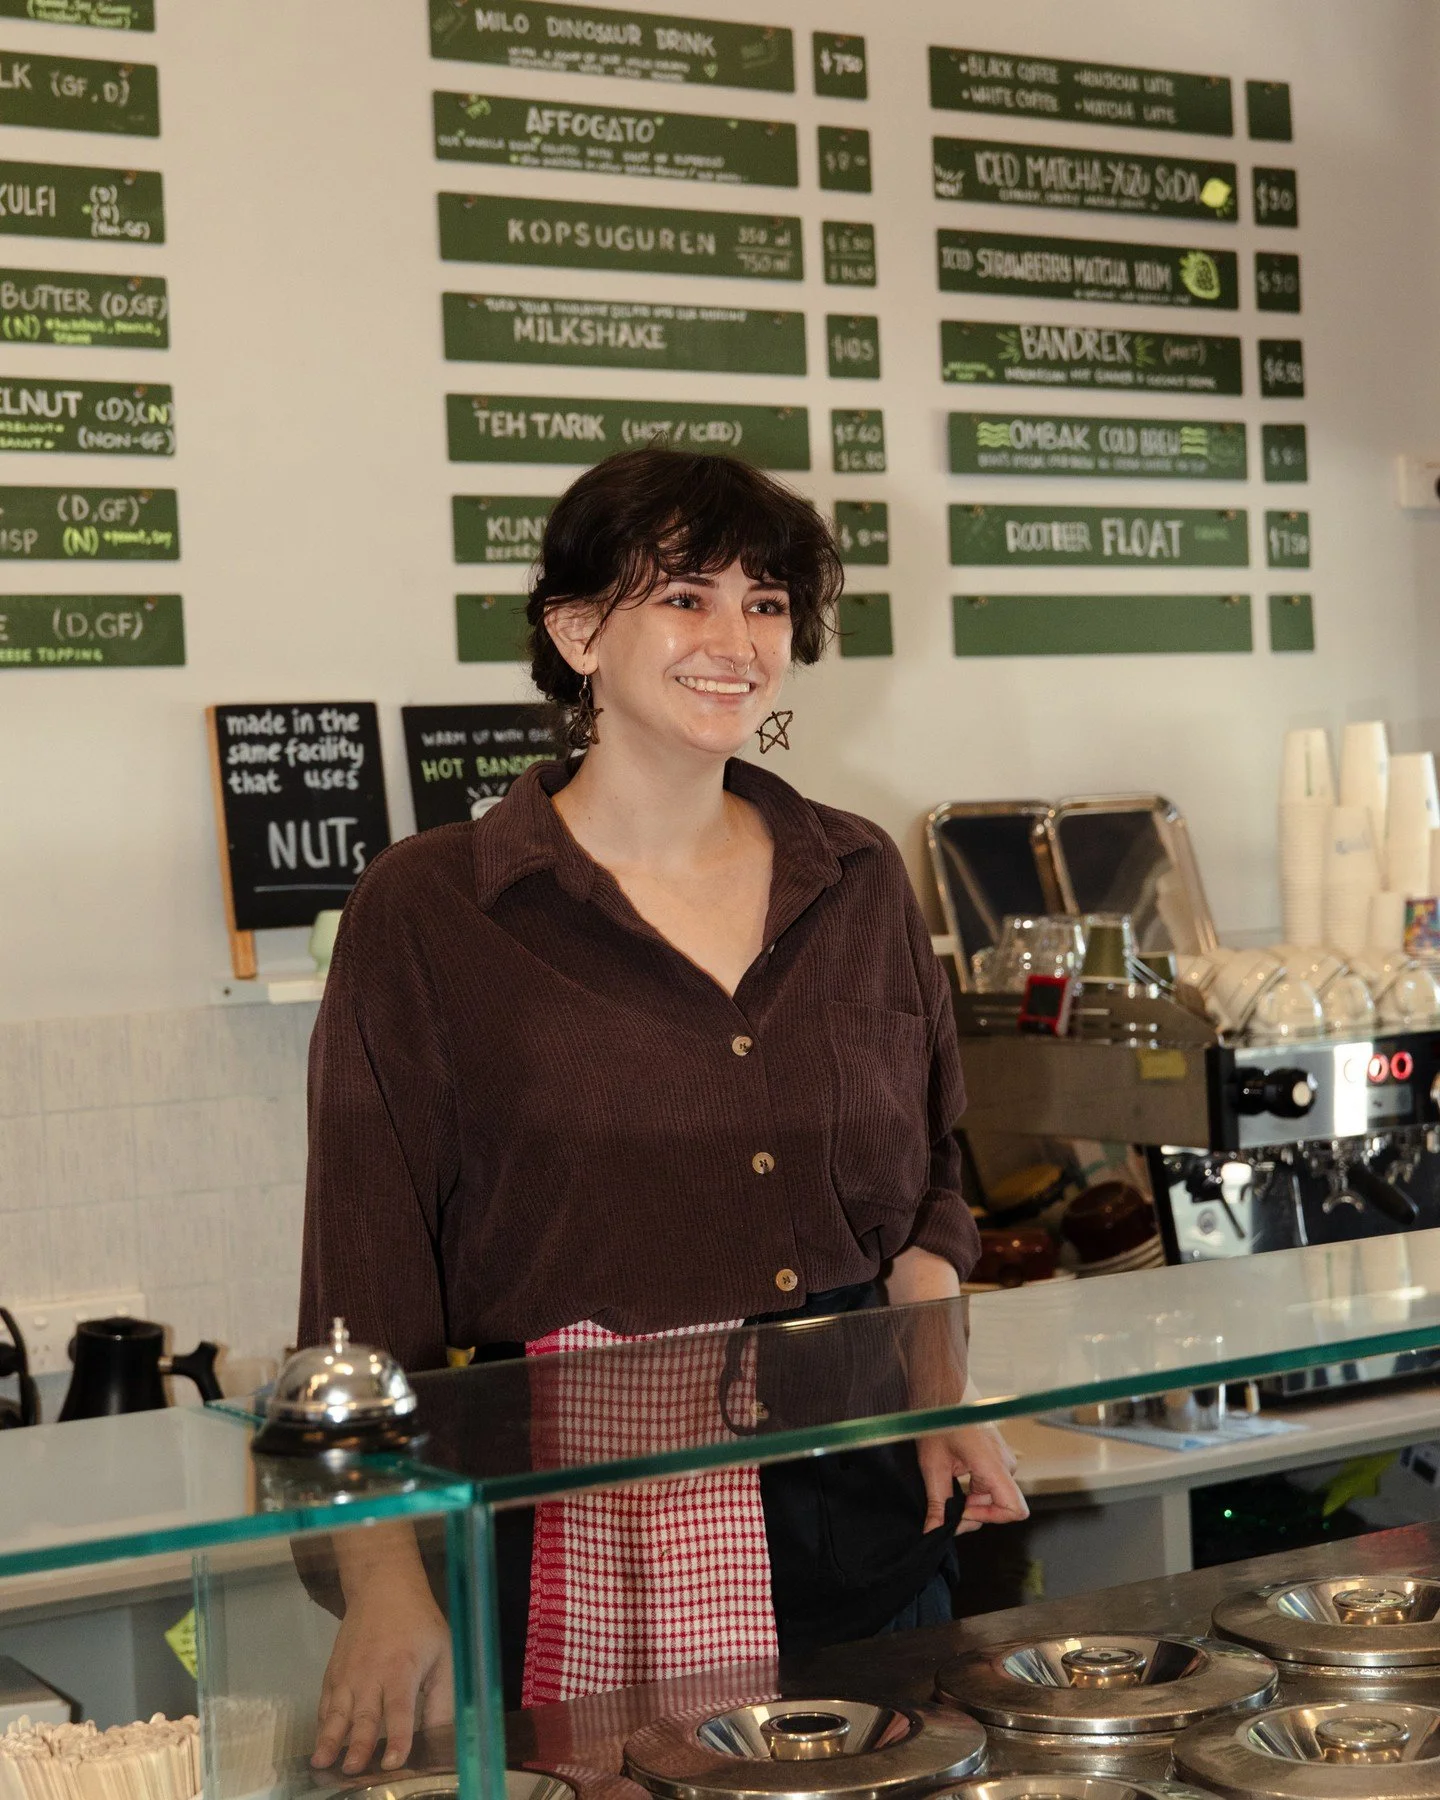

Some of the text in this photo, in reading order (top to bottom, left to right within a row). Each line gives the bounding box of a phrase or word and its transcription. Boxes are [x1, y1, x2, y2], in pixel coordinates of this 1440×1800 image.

[475, 8, 718, 58] MILO DINOSAUR DRINK
[525, 105, 656, 143] AFFOGATO
[0, 183, 56, 217] KULFI
[507, 218, 717, 256] KOPSUGUREN
[0, 280, 92, 313] BUTTER
[513, 315, 668, 349] MILKSHAKE
[1020, 324, 1133, 363] BANDREK
[474, 410, 527, 439] TEH
[530, 411, 606, 441] TARIK
[1009, 418, 1092, 451] OMBAK
[1101, 516, 1184, 558] FLOAT
[226, 708, 360, 735] made in the
[421, 730, 467, 747] WARM
[472, 729, 491, 745] UP
[492, 728, 525, 744] WITH
[226, 738, 364, 768] same facility
[421, 756, 465, 783] HOT
[228, 766, 360, 796] that uses
